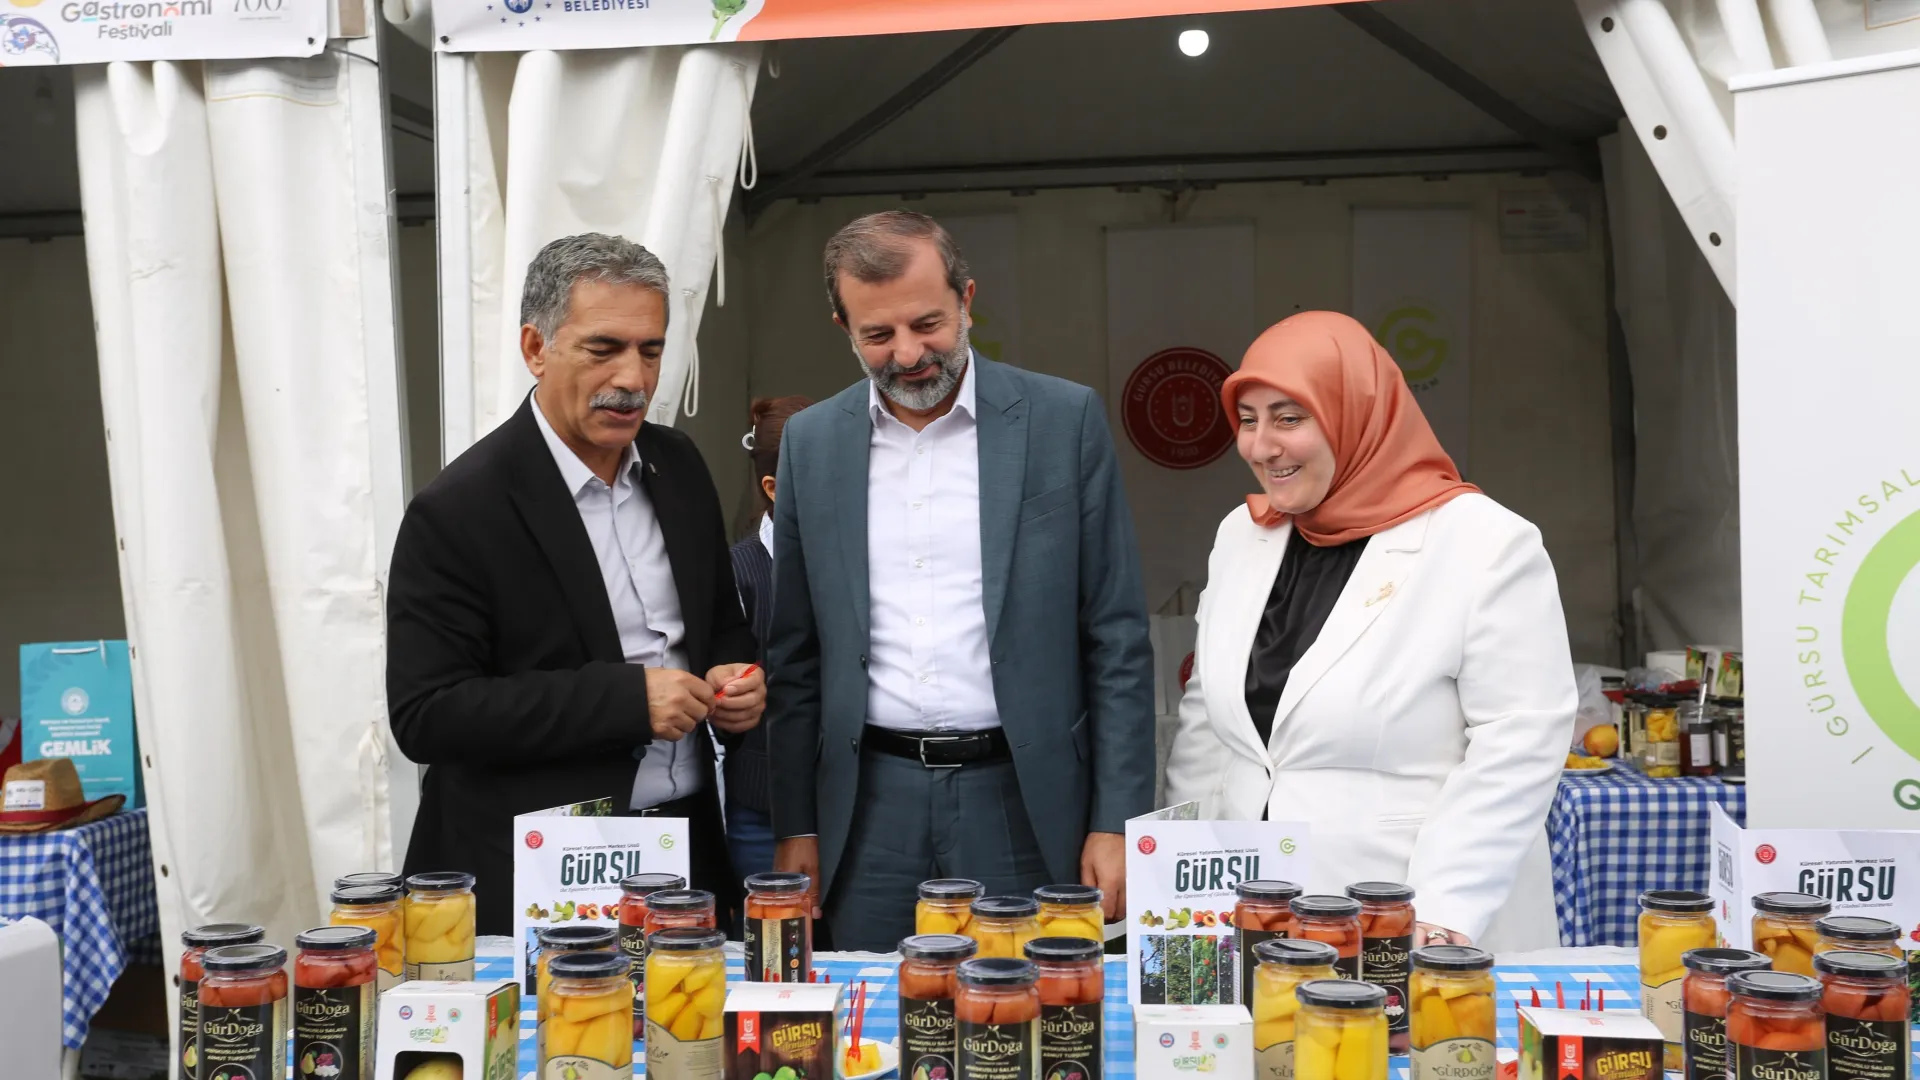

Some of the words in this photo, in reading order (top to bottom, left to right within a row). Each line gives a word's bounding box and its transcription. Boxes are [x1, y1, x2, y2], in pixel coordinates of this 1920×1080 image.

[560, 850, 641, 886] GÜRSU
[1175, 855, 1260, 892] GÜRSU
[1798, 865, 1896, 902] GÜRSU
[620, 937, 645, 950] GürD
[772, 1022, 822, 1048] GÜRSU
[1689, 1028, 1726, 1046] GürD
[1596, 1050, 1652, 1076] GÜRSU
